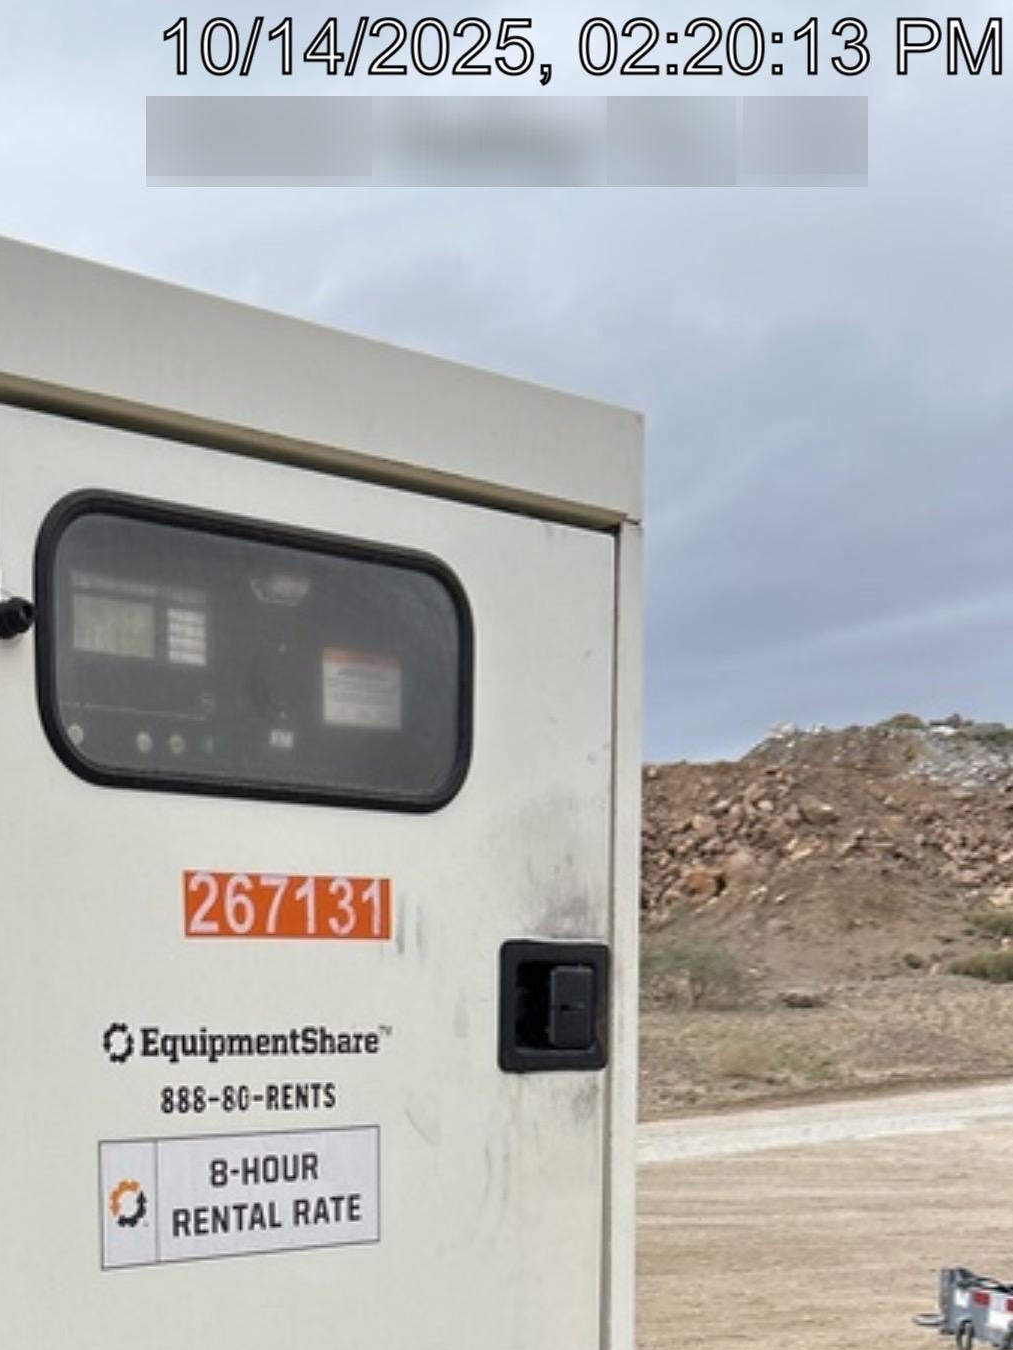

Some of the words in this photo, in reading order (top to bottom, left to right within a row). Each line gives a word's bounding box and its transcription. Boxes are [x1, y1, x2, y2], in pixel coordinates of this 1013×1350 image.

[188, 872, 382, 936] 267131
[140, 1026, 380, 1063] EquipmentShare
[161, 1082, 337, 1114] 888-80-RENTS
[209, 1152, 319, 1188] 8-HOUR
[172, 1201, 283, 1237] RENTAL
[292, 1193, 362, 1227] RATE
